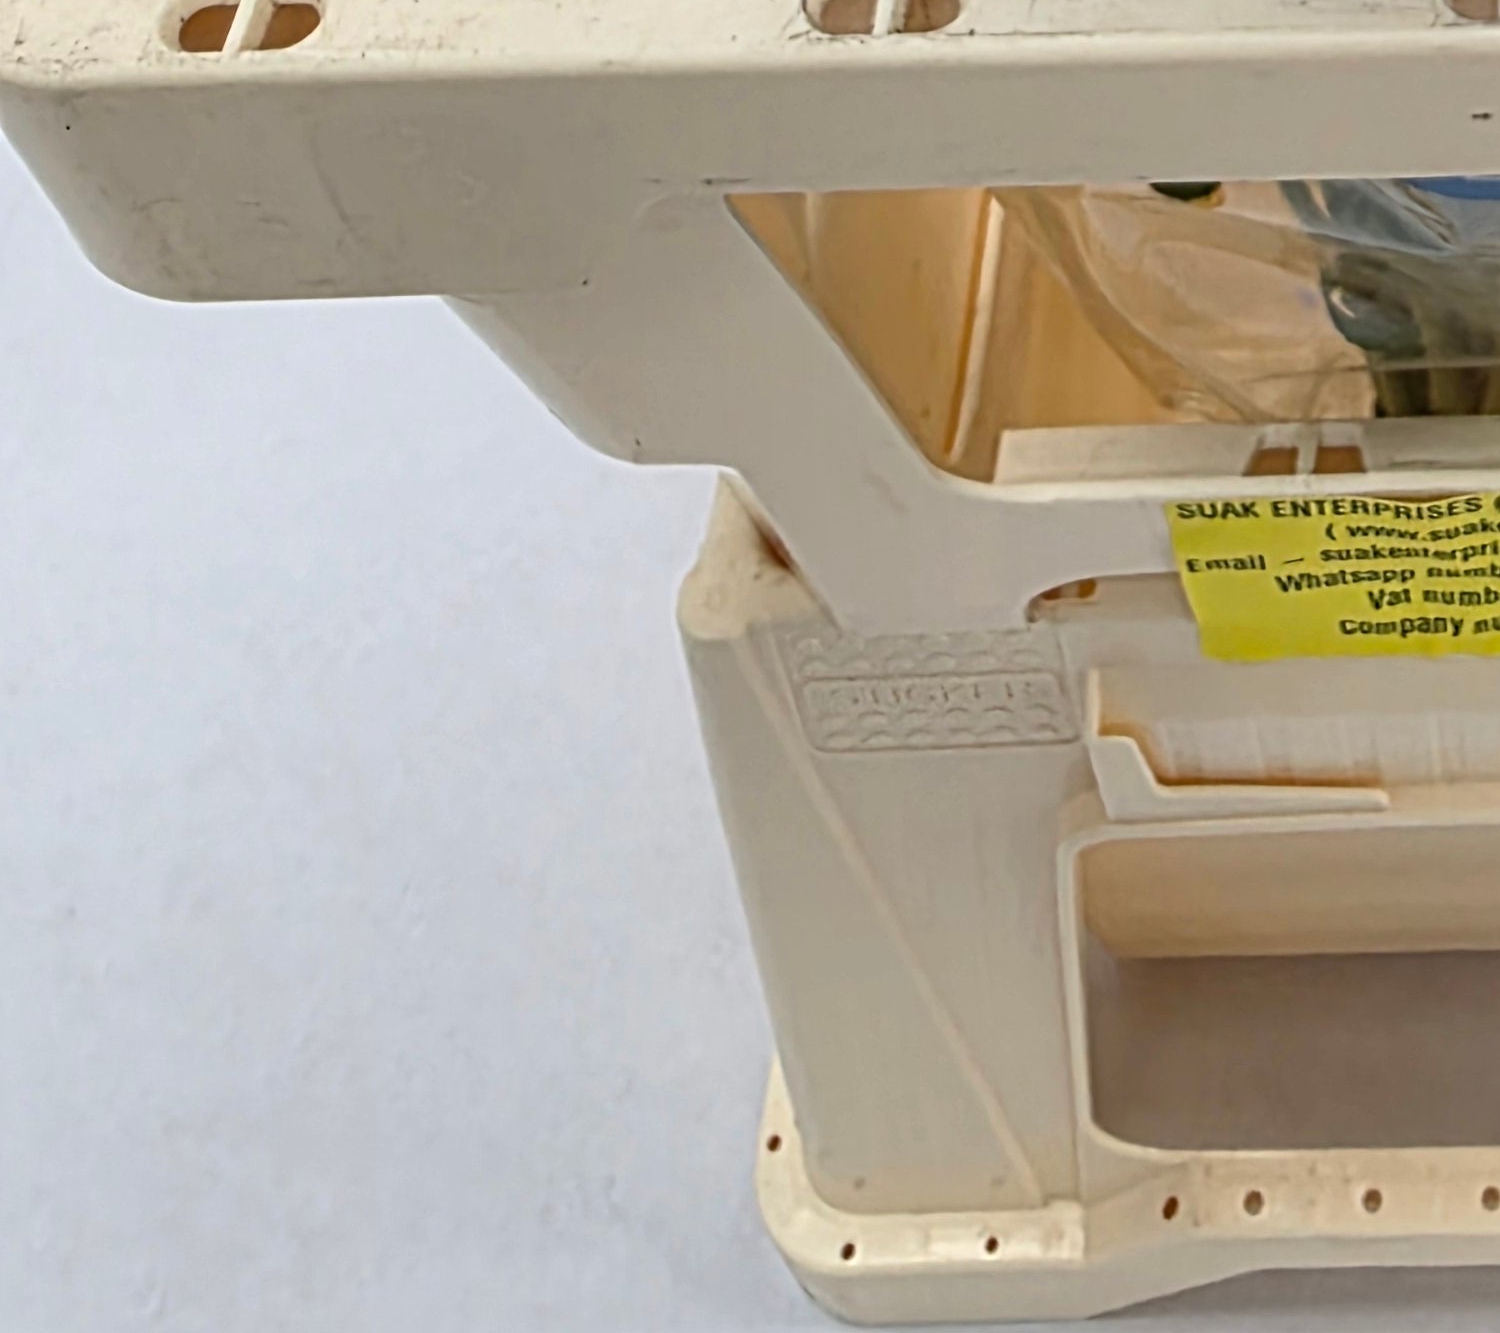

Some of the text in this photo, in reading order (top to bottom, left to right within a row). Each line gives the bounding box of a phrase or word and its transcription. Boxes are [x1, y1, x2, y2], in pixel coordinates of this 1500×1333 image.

[1176, 500, 1260, 520] SUAK
[1271, 496, 1483, 521] ENTERPRISES
[1185, 554, 1267, 574] Email
[1274, 568, 1416, 594] Whatsapp
[1367, 588, 1412, 610] Vat
[1339, 616, 1464, 638] Company
